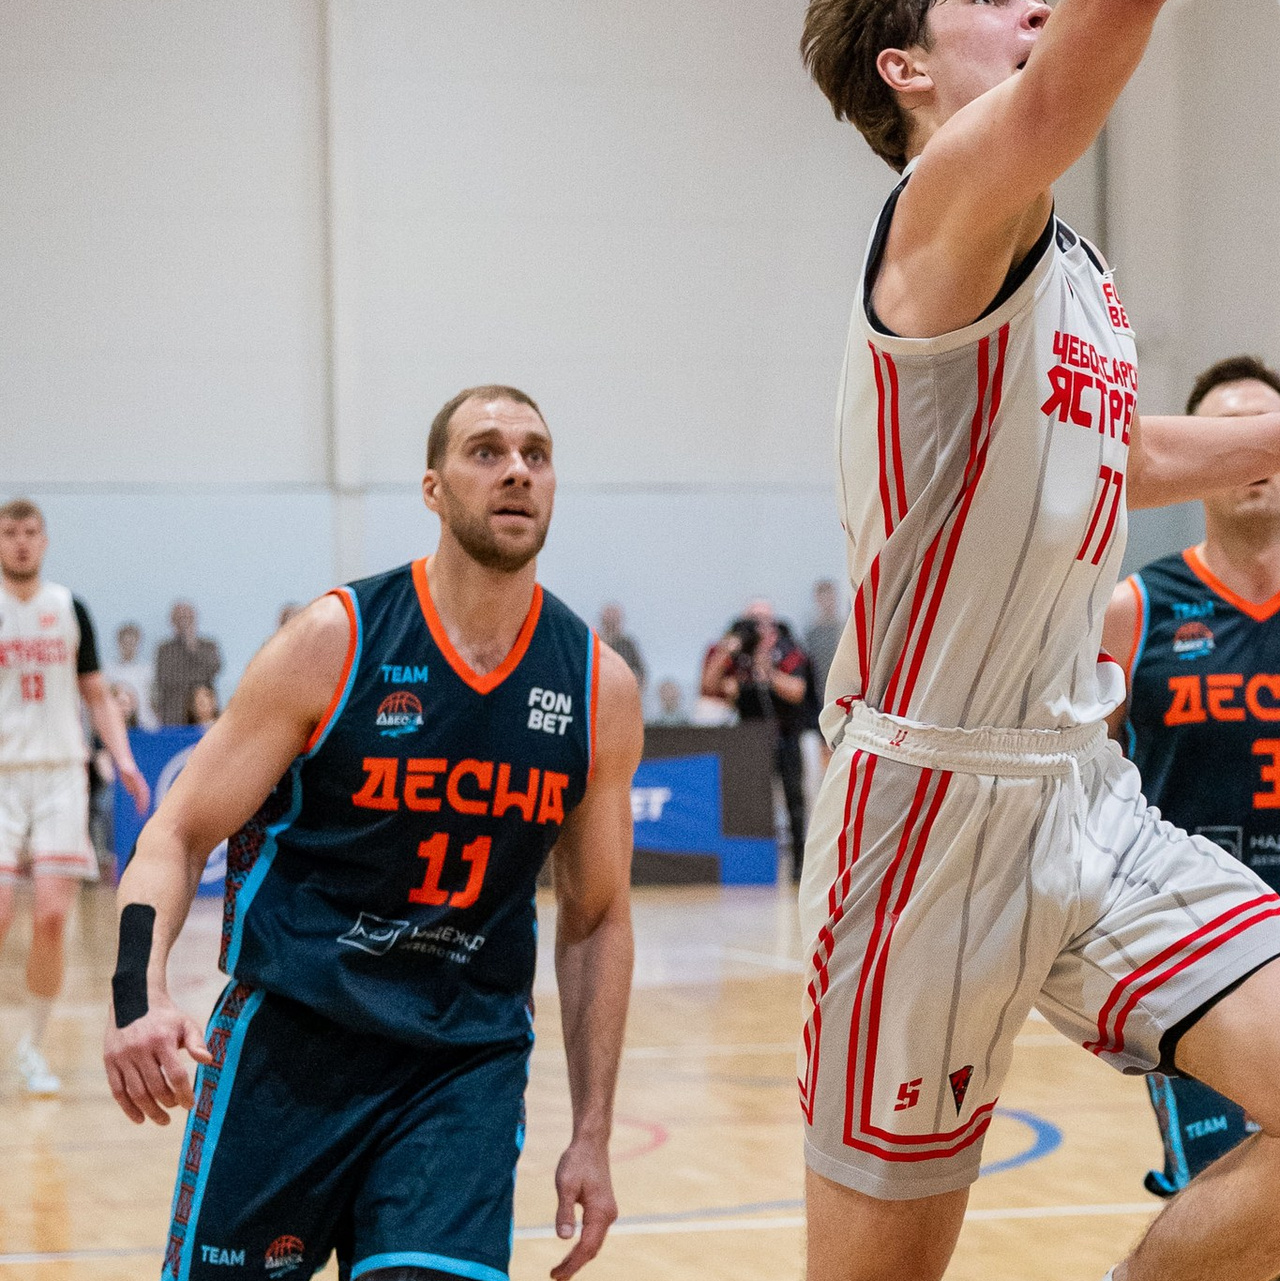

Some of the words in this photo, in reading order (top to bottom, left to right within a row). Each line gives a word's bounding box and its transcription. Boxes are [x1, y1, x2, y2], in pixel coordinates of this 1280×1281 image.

[1040, 364, 1137, 447] ЯСТРЕ
[1076, 463, 1124, 566] 77
[1171, 600, 1215, 620] TEAM
[381, 664, 429, 684] TEAM
[527, 686, 573, 714] FON
[527, 707, 574, 736] BET
[351, 756, 570, 826] ДЕСНА
[408, 831, 493, 909] 11
[201, 1244, 247, 1267] TEAM
